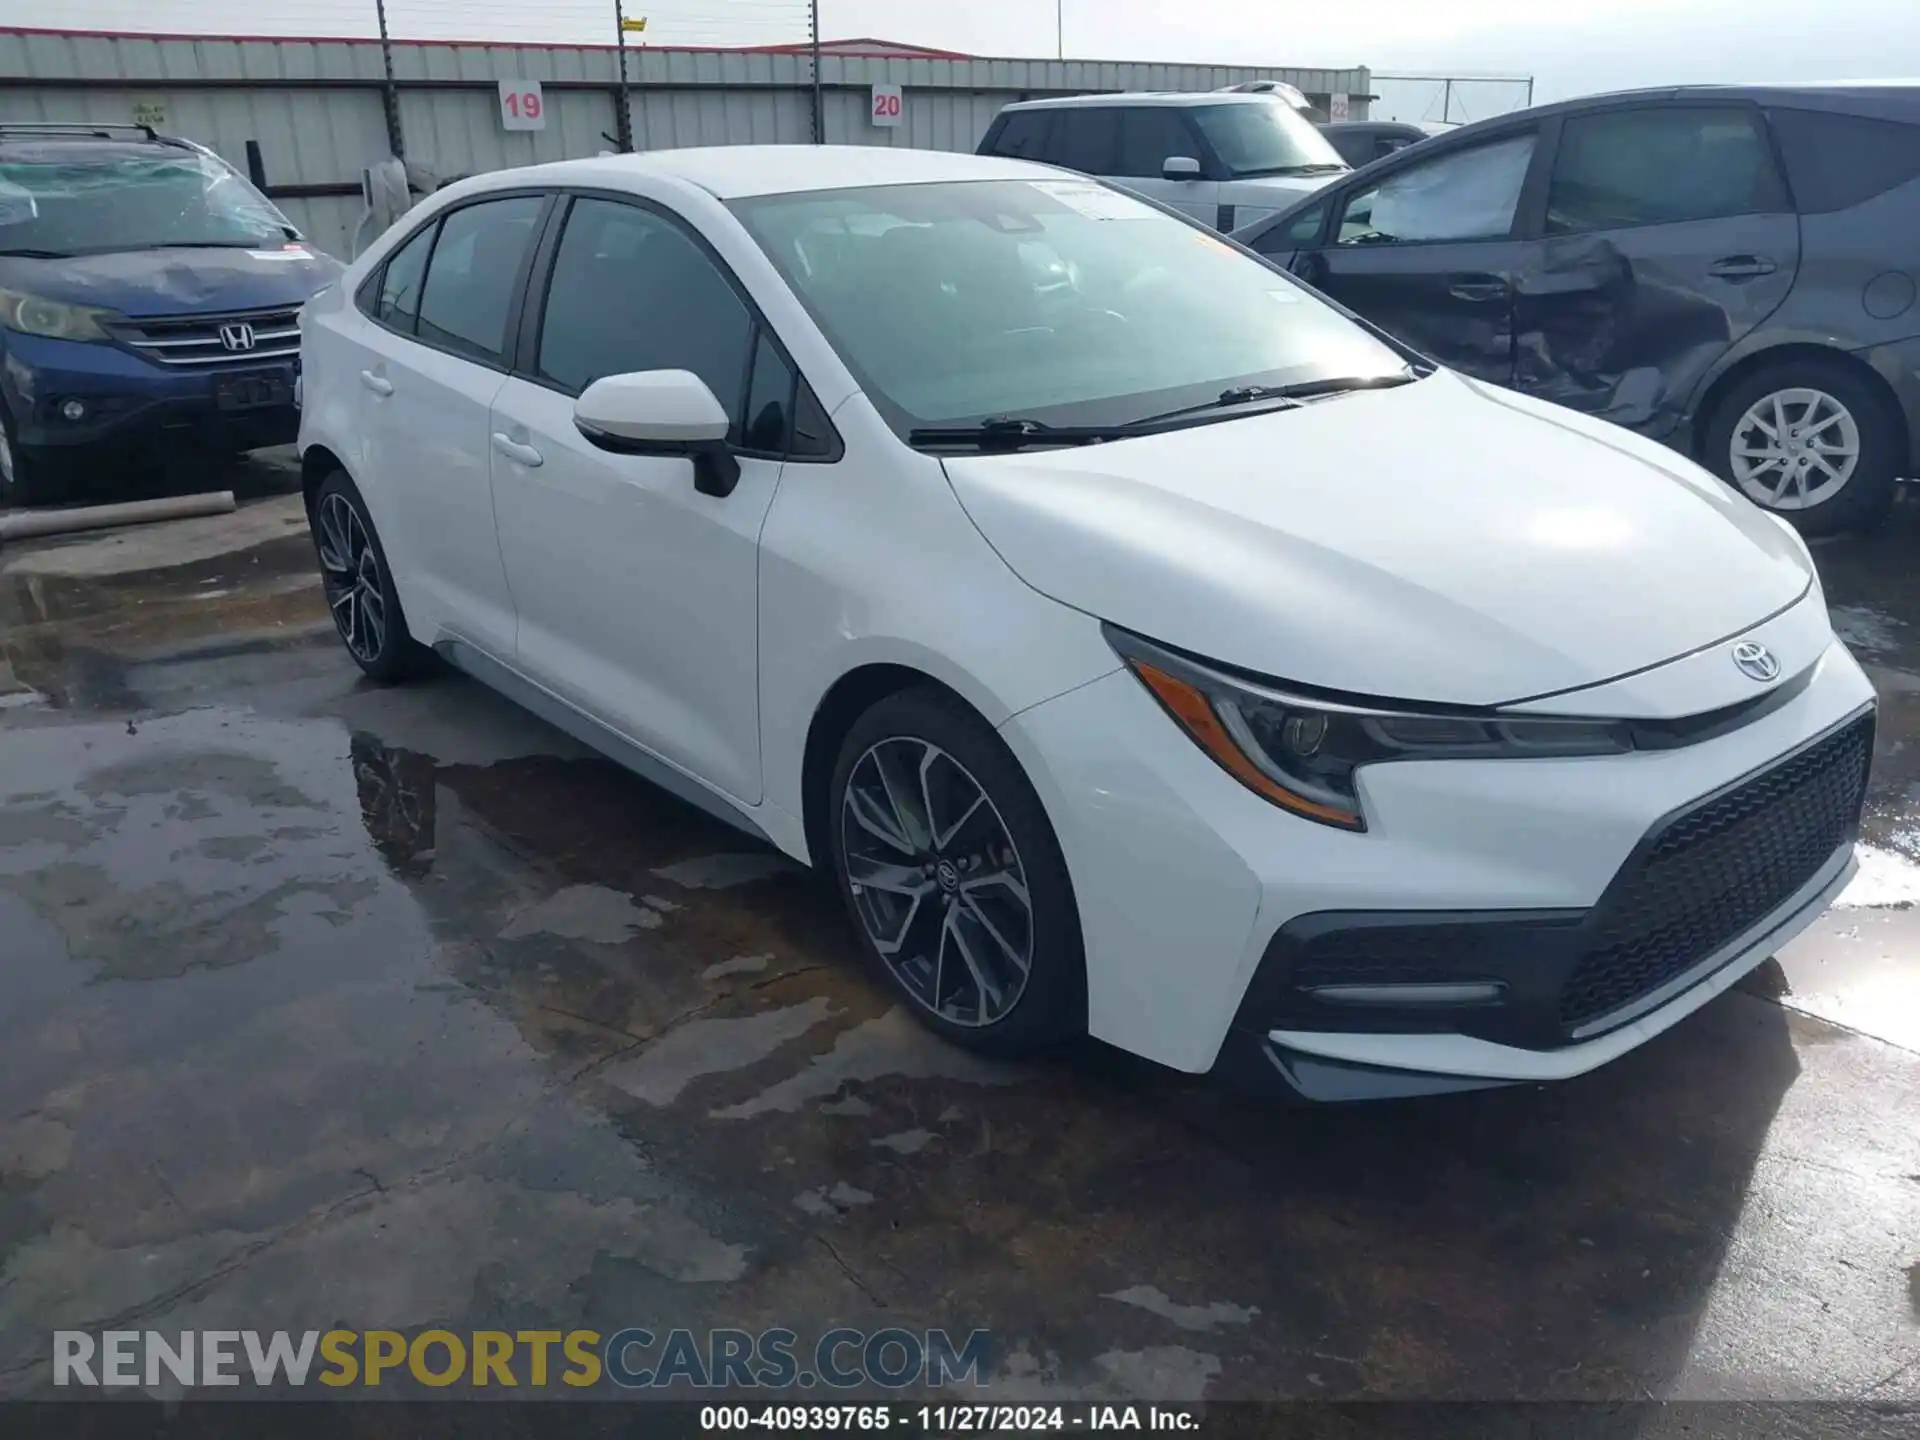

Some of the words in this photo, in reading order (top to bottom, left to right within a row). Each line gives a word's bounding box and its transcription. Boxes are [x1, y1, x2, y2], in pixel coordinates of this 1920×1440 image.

[505, 92, 541, 120] 19
[874, 95, 900, 117] 20
[1332, 101, 1347, 117] 22
